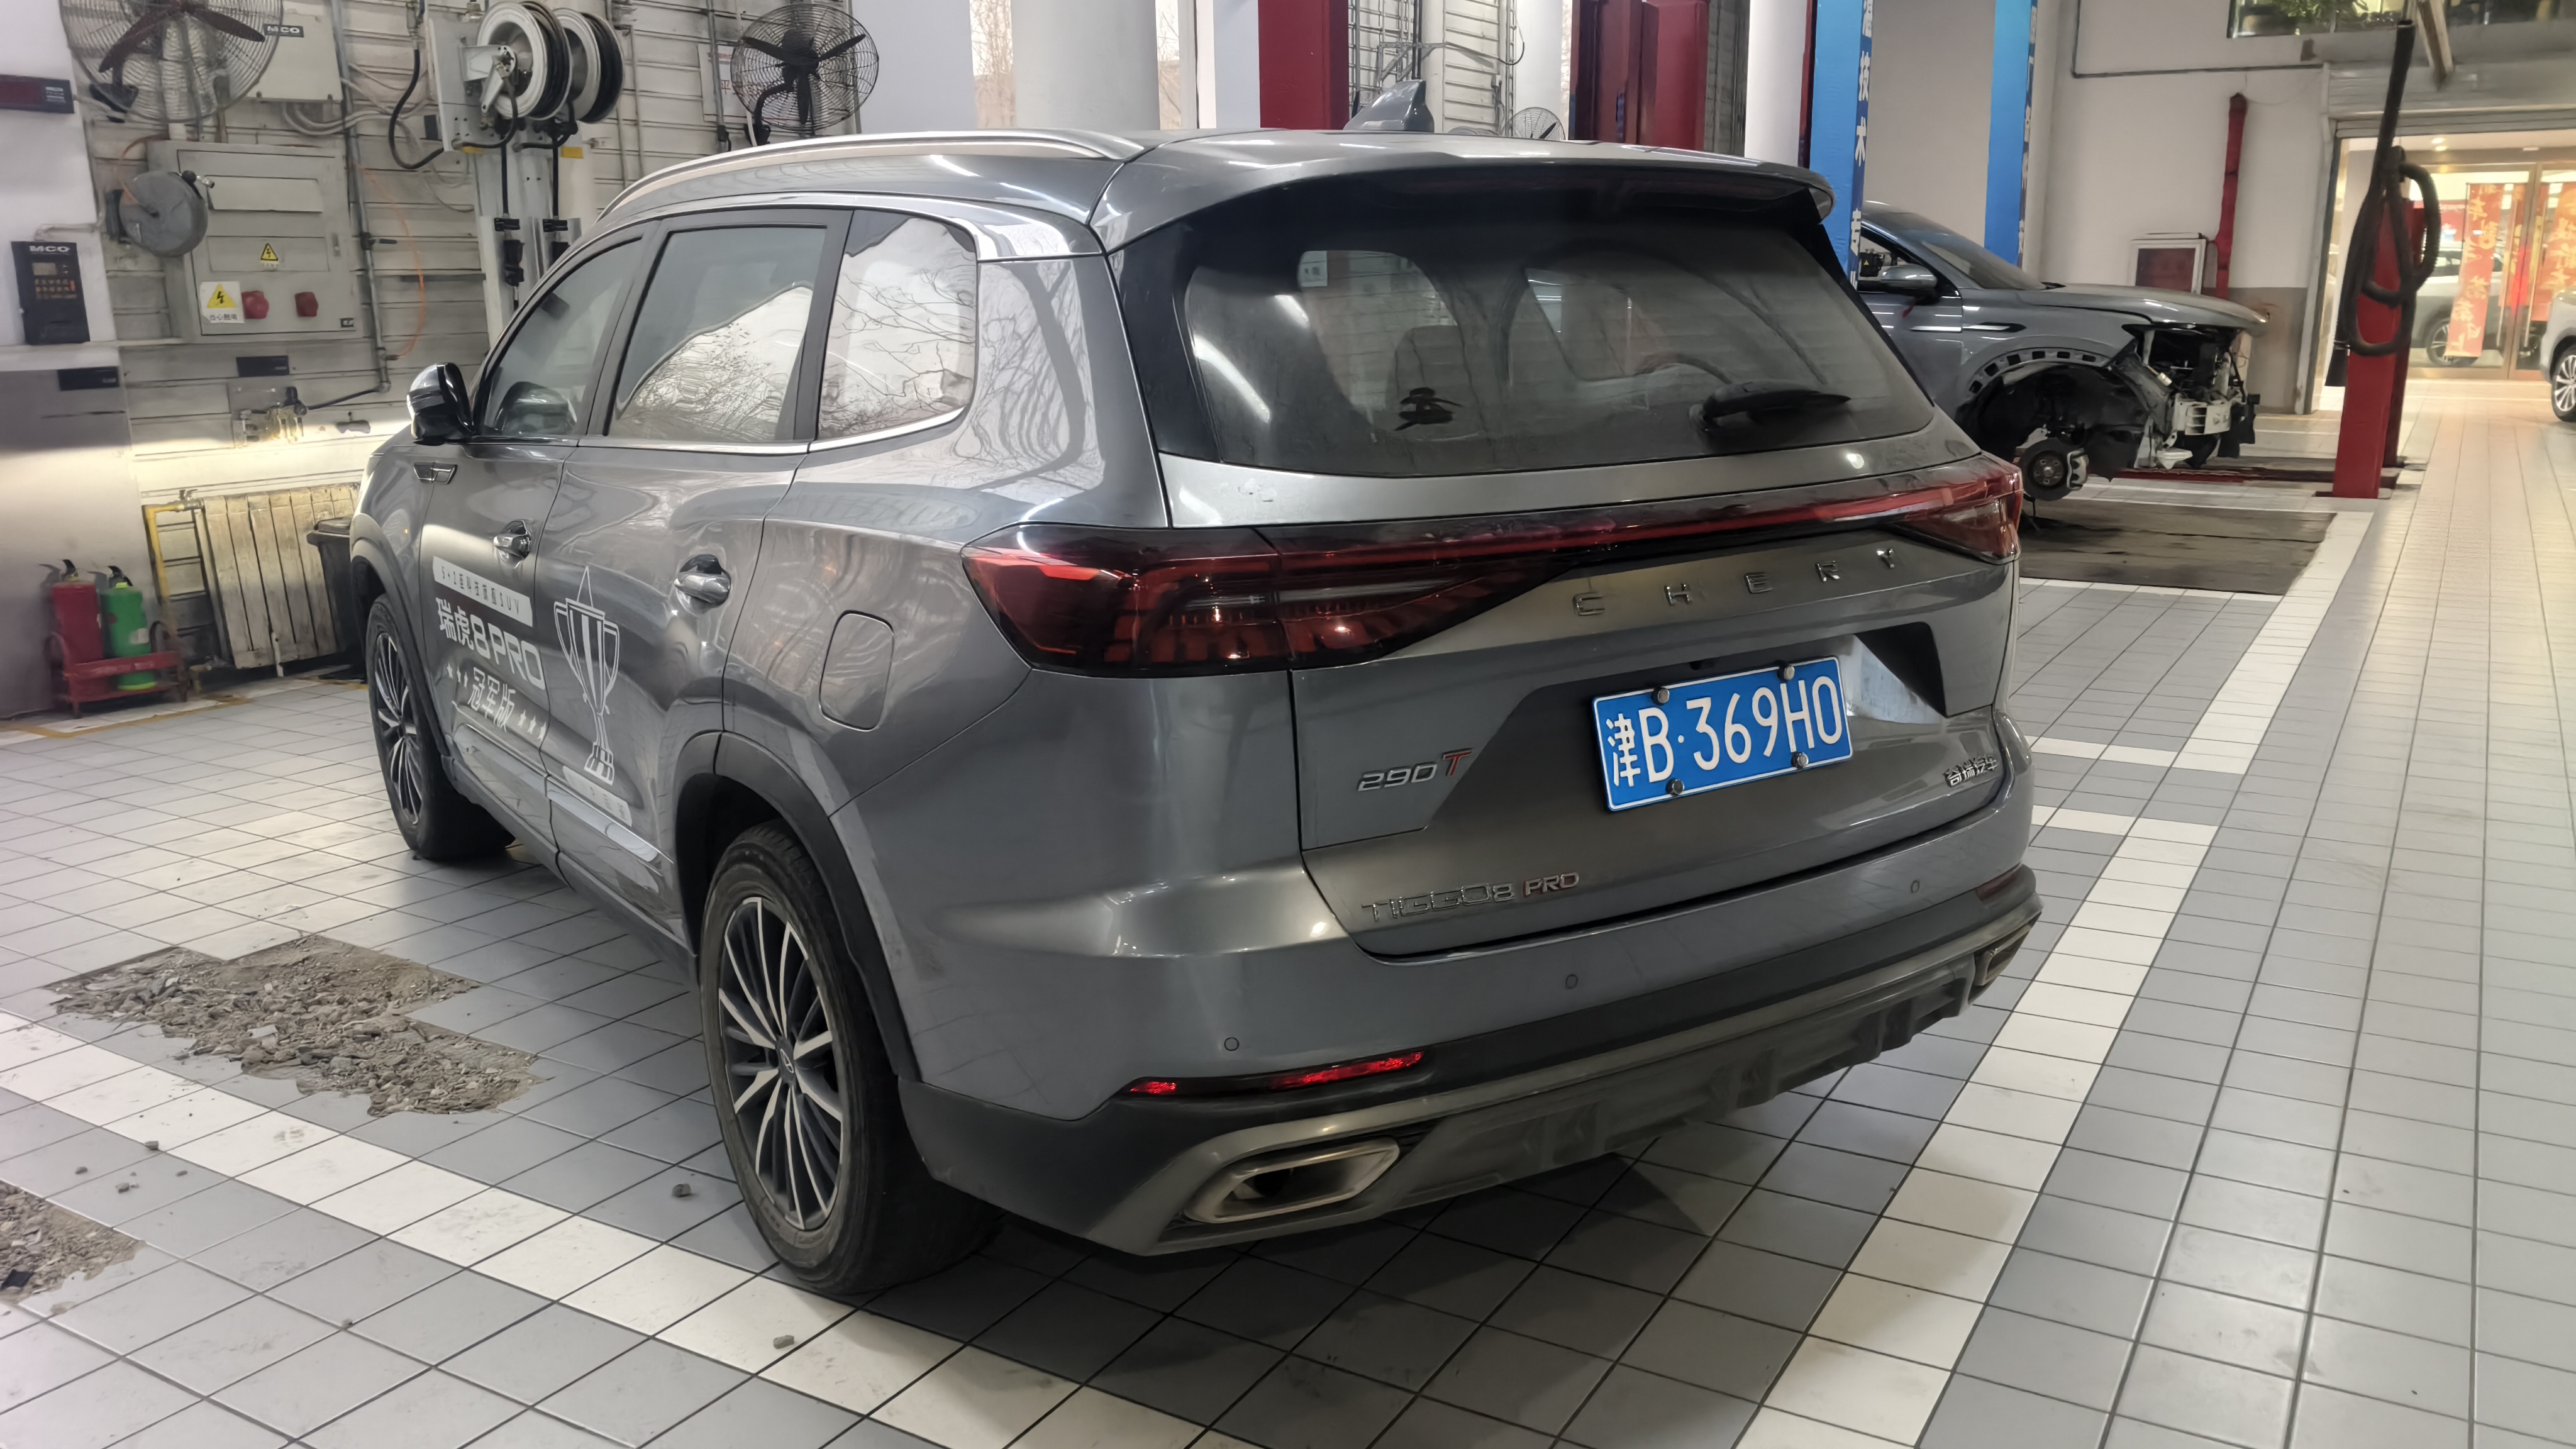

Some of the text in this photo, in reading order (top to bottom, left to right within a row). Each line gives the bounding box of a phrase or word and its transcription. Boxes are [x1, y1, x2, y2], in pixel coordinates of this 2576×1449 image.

[1574, 547, 1896, 616] CHERY
[467, 667, 516, 733] 冠军版
[1523, 872, 1580, 898] PRO
